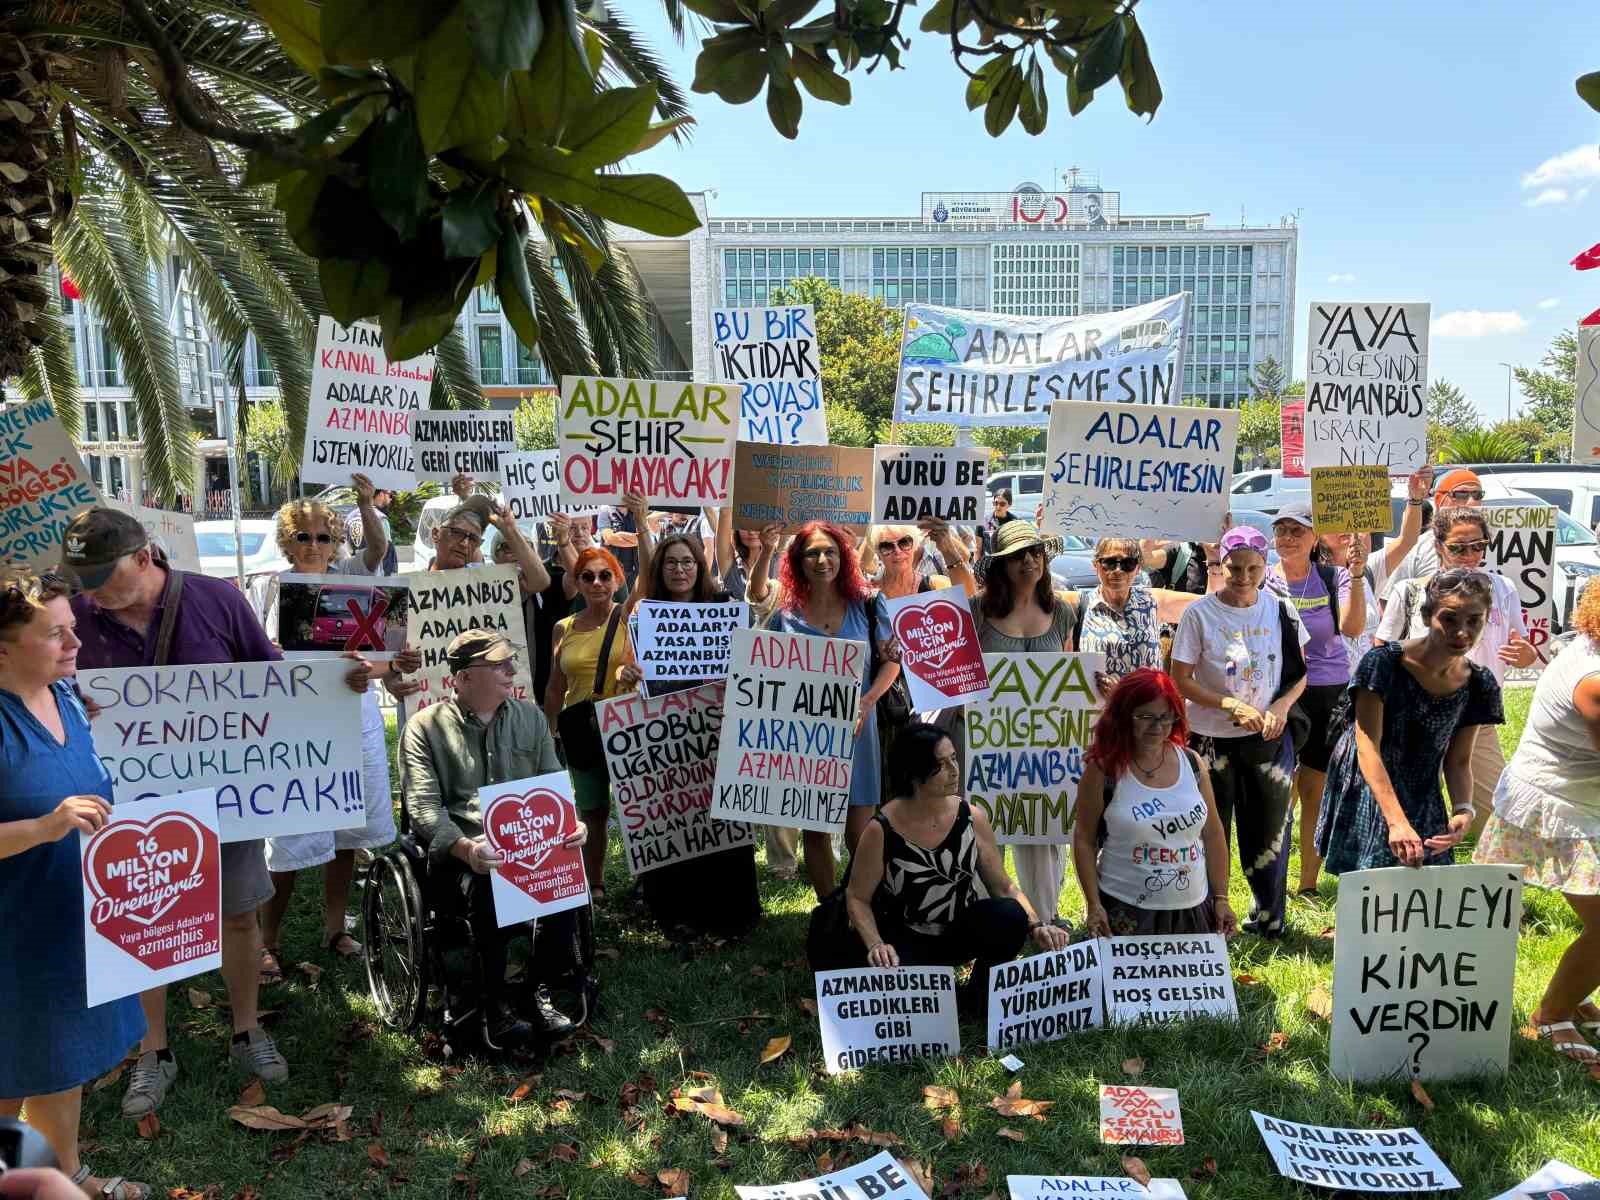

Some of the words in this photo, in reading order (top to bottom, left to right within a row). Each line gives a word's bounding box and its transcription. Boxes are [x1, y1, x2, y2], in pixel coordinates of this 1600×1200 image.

[714, 311, 750, 342] BU
[765, 308, 815, 340] BİR
[1316, 306, 1419, 354] YAYA
[321, 348, 380, 376] KANAL
[964, 327, 1103, 366] ADALAR
[1311, 347, 1428, 383] BÖLGESİNDE
[326, 382, 420, 411] ADALAR'DA
[564, 378, 731, 426] ADALAR
[738, 380, 820, 418] ROVASI
[904, 362, 1174, 415] ŞEHİRLEŞMESİN
[1307, 382, 1423, 419] AZMANBÜS
[414, 413, 513, 443] AZMANBÜSLERİ
[584, 420, 696, 459] ŞEHİR
[1085, 411, 1222, 452] ADALAR
[1313, 418, 1381, 444] ISRARI
[422, 445, 451, 473] GERİ
[1340, 437, 1420, 468] NİYE?
[505, 458, 537, 490] HİÇ
[564, 453, 732, 500] OLMAYACAK!
[880, 453, 947, 486] YÜRÜ
[955, 460, 985, 486] BE
[1050, 451, 1225, 494] ŞEHİRLEŞMESİN
[883, 495, 978, 522] ADALAR
[408, 580, 515, 614] AZMANBÜS
[648, 607, 692, 619] YAYA
[696, 606, 740, 619] YOLU
[906, 621, 954, 640] MİLYON
[920, 614, 934, 626] 16
[654, 636, 697, 647] YASA
[750, 636, 859, 678] ADALAR
[919, 633, 945, 648] İÇİN
[89, 664, 319, 709] SOKAKLAR
[987, 656, 1097, 706] YAYA
[114, 711, 270, 747] YENİDEN
[607, 705, 725, 755] OTOBÜS
[738, 717, 855, 760] KARAYOLU
[612, 733, 720, 780] UĞRUNA
[738, 751, 849, 789] AZMANBÜS
[966, 747, 1084, 793] AZMANBÜ
[134, 769, 364, 819] ACAK!!!
[719, 783, 775, 816] KABUL
[780, 785, 849, 825] EDİLMEZ
[1131, 797, 1167, 821] ADA
[499, 813, 555, 837] MİLYON
[517, 806, 533, 819] 16
[629, 817, 687, 844] KALAN
[691, 809, 709, 826] AT
[136, 836, 159, 855] 16
[514, 828, 545, 846] İÇİN
[106, 847, 189, 880] MİLYON
[126, 867, 171, 893] İÇİN
[96, 873, 205, 925] Direniyoruz
[527, 873, 574, 894] azmanbüs
[553, 882, 585, 899] olamaz
[1361, 873, 1519, 934] İHALEYİ
[119, 931, 142, 945] Yaya
[143, 922, 175, 939] bölgesi
[175, 911, 215, 930] Adalar'da
[138, 927, 204, 957] azmanbüs
[172, 939, 219, 963] olamaz
[1111, 940, 1215, 960] HOŞÇAKAL
[821, 968, 952, 997] AZMANBÜSLER
[993, 944, 1098, 993] ADALAR'DA
[1112, 959, 1225, 980] AZMANBÜS
[1361, 946, 1478, 994] KİME
[837, 992, 940, 1019] GELDİKLERİ
[1000, 978, 1091, 1019] YÜRÜMEK
[1112, 988, 1151, 1007] HOŞ
[1157, 982, 1226, 1002] GELSİN
[874, 1016, 912, 1040] GİBİ
[997, 1007, 1094, 1049] İSTİYORUZ
[1350, 996, 1499, 1035] VERDİN
[1407, 1032, 1430, 1074] ?
[1103, 1087, 1148, 1098] ADA
[1110, 1097, 1162, 1109] YAYA
[1121, 1108, 1175, 1120] YOLU
[1263, 1117, 1420, 1147] ADALAR'DA
[1280, 1138, 1424, 1167] YÜRÜMEK
[856, 1164, 908, 1200] BE
[1040, 1178, 1142, 1193] ADALAR
[1287, 1157, 1444, 1188] İSTİYORUZ
